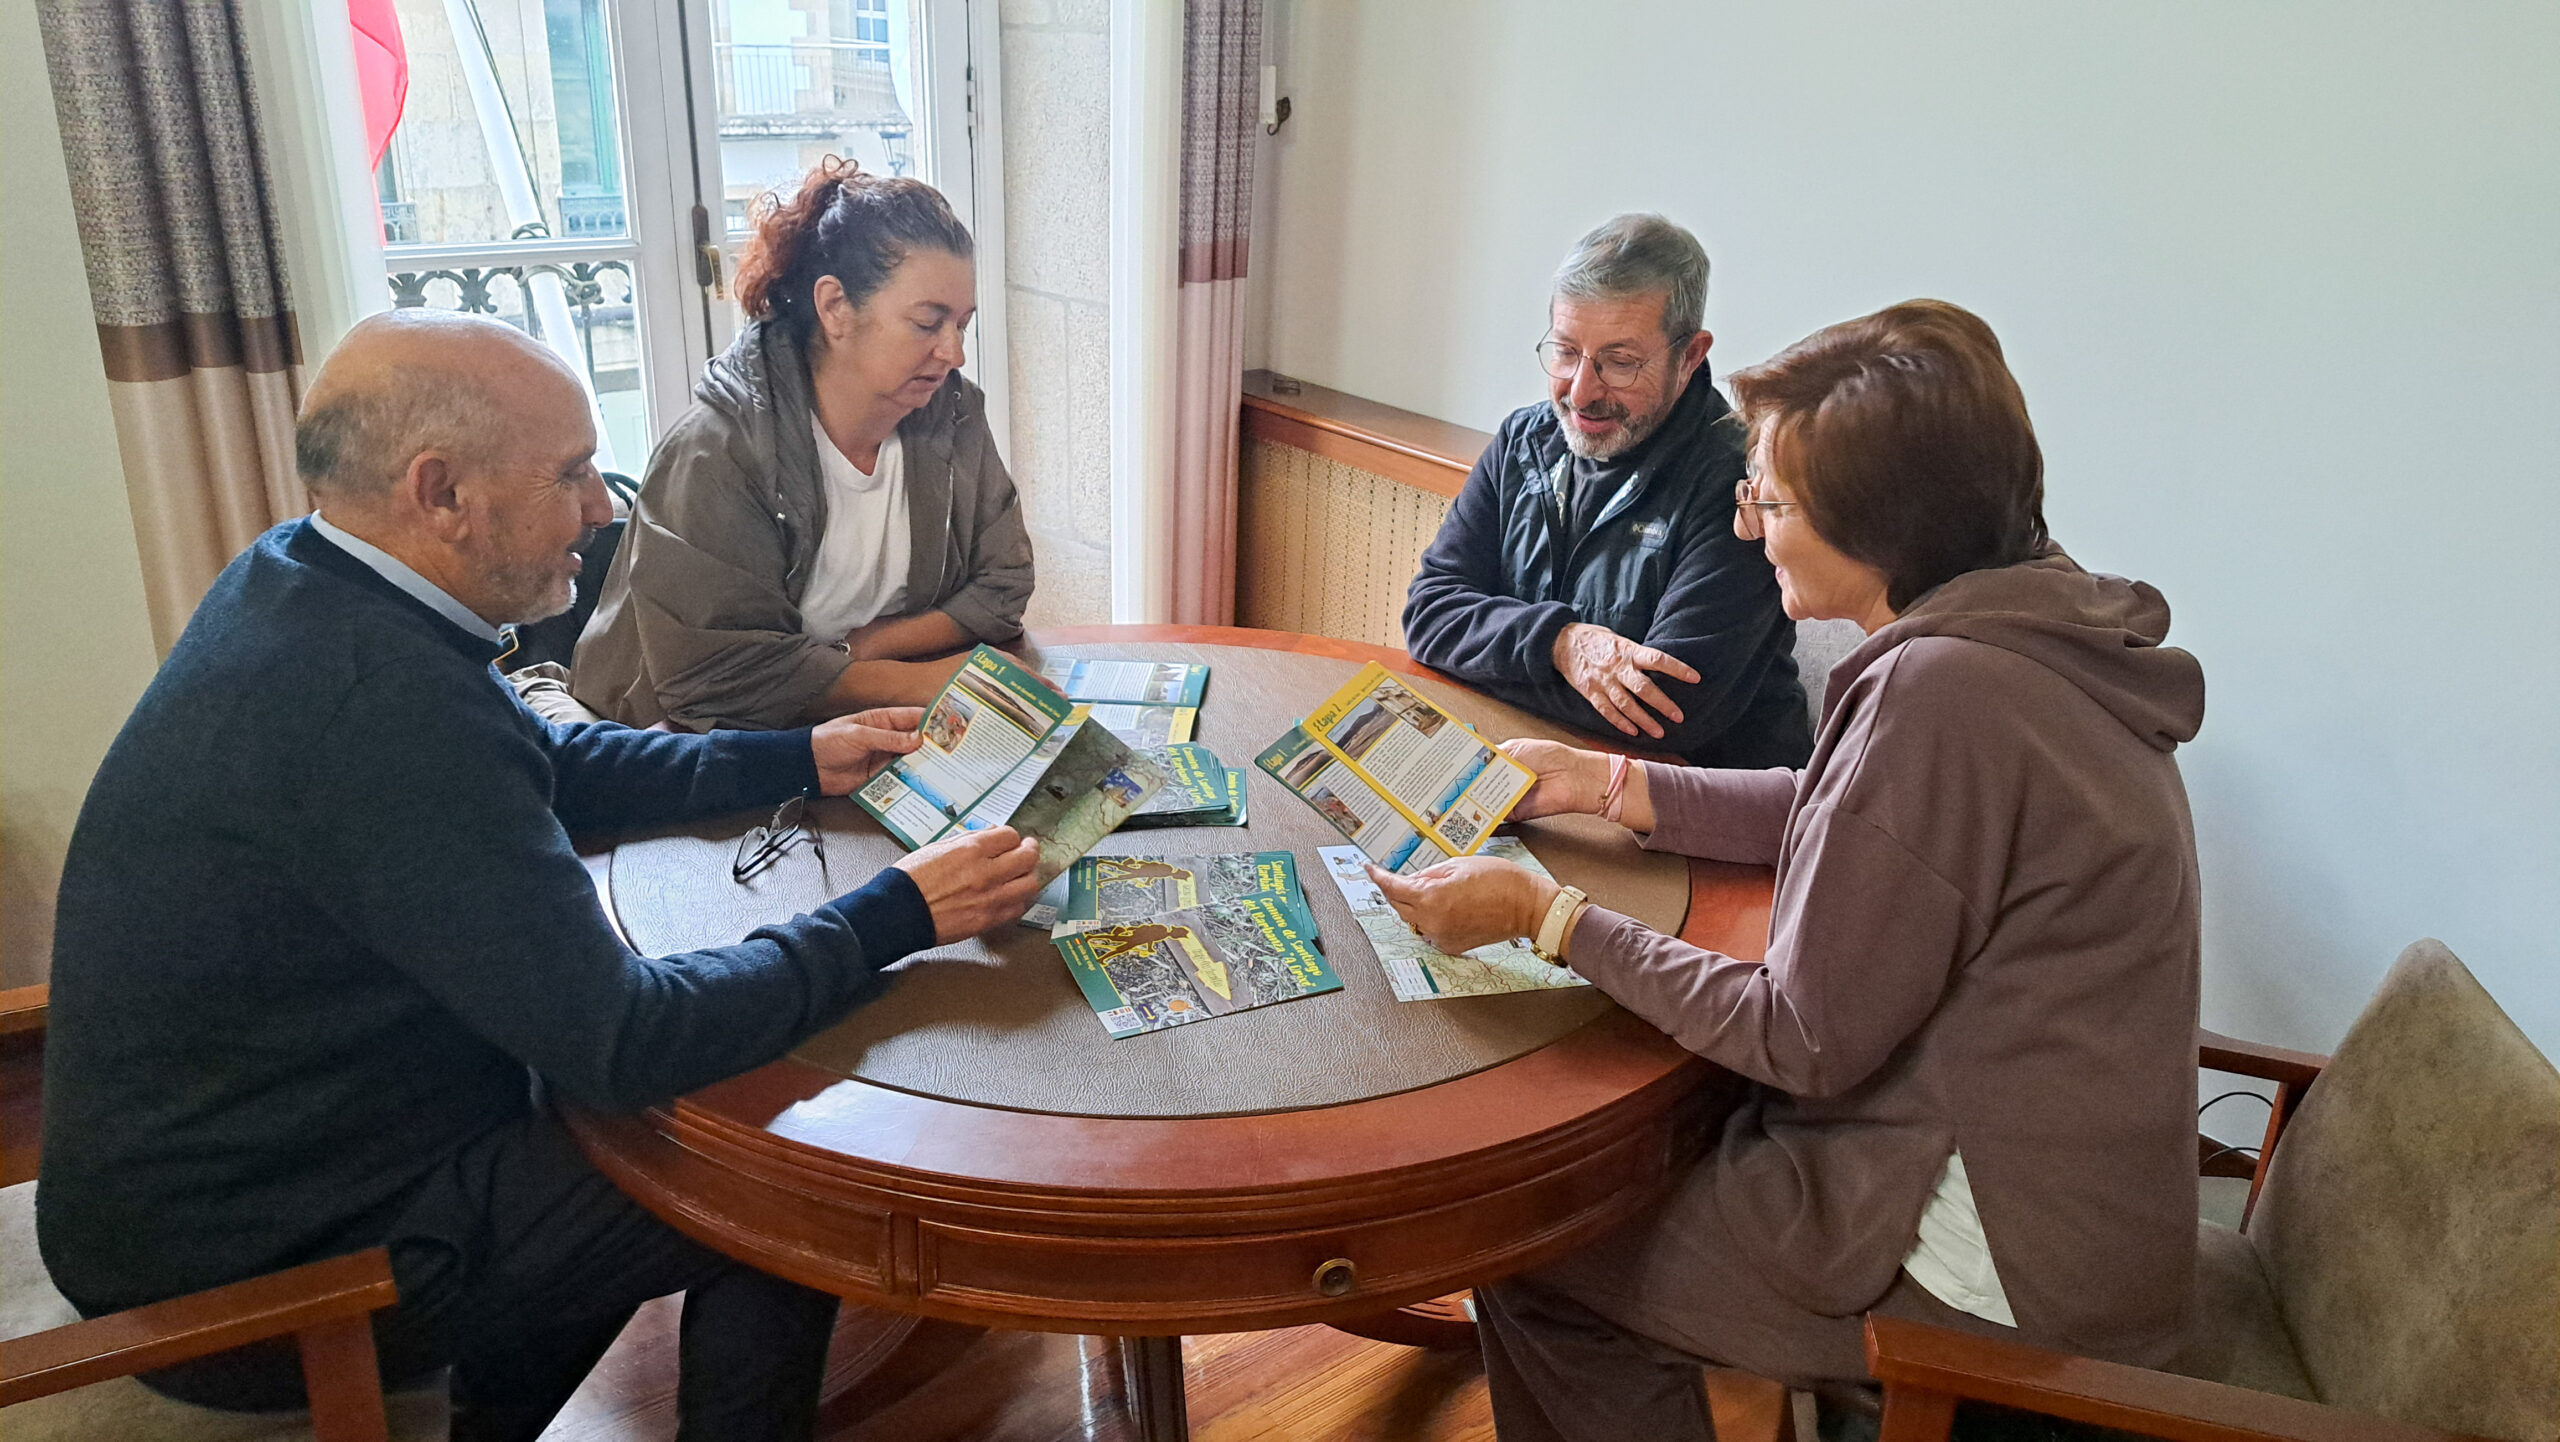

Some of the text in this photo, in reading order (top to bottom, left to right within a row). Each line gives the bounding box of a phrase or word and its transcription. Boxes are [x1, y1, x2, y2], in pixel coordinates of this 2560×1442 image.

[973, 650, 998, 672] Etapa
[1312, 710, 1338, 732] Etapa
[1242, 899, 1260, 912] del
[1251, 912, 1286, 953] Barbanza
[1260, 898, 1288, 928] Camino
[1282, 929, 1297, 940] de
[1290, 940, 1323, 976] Santiago
